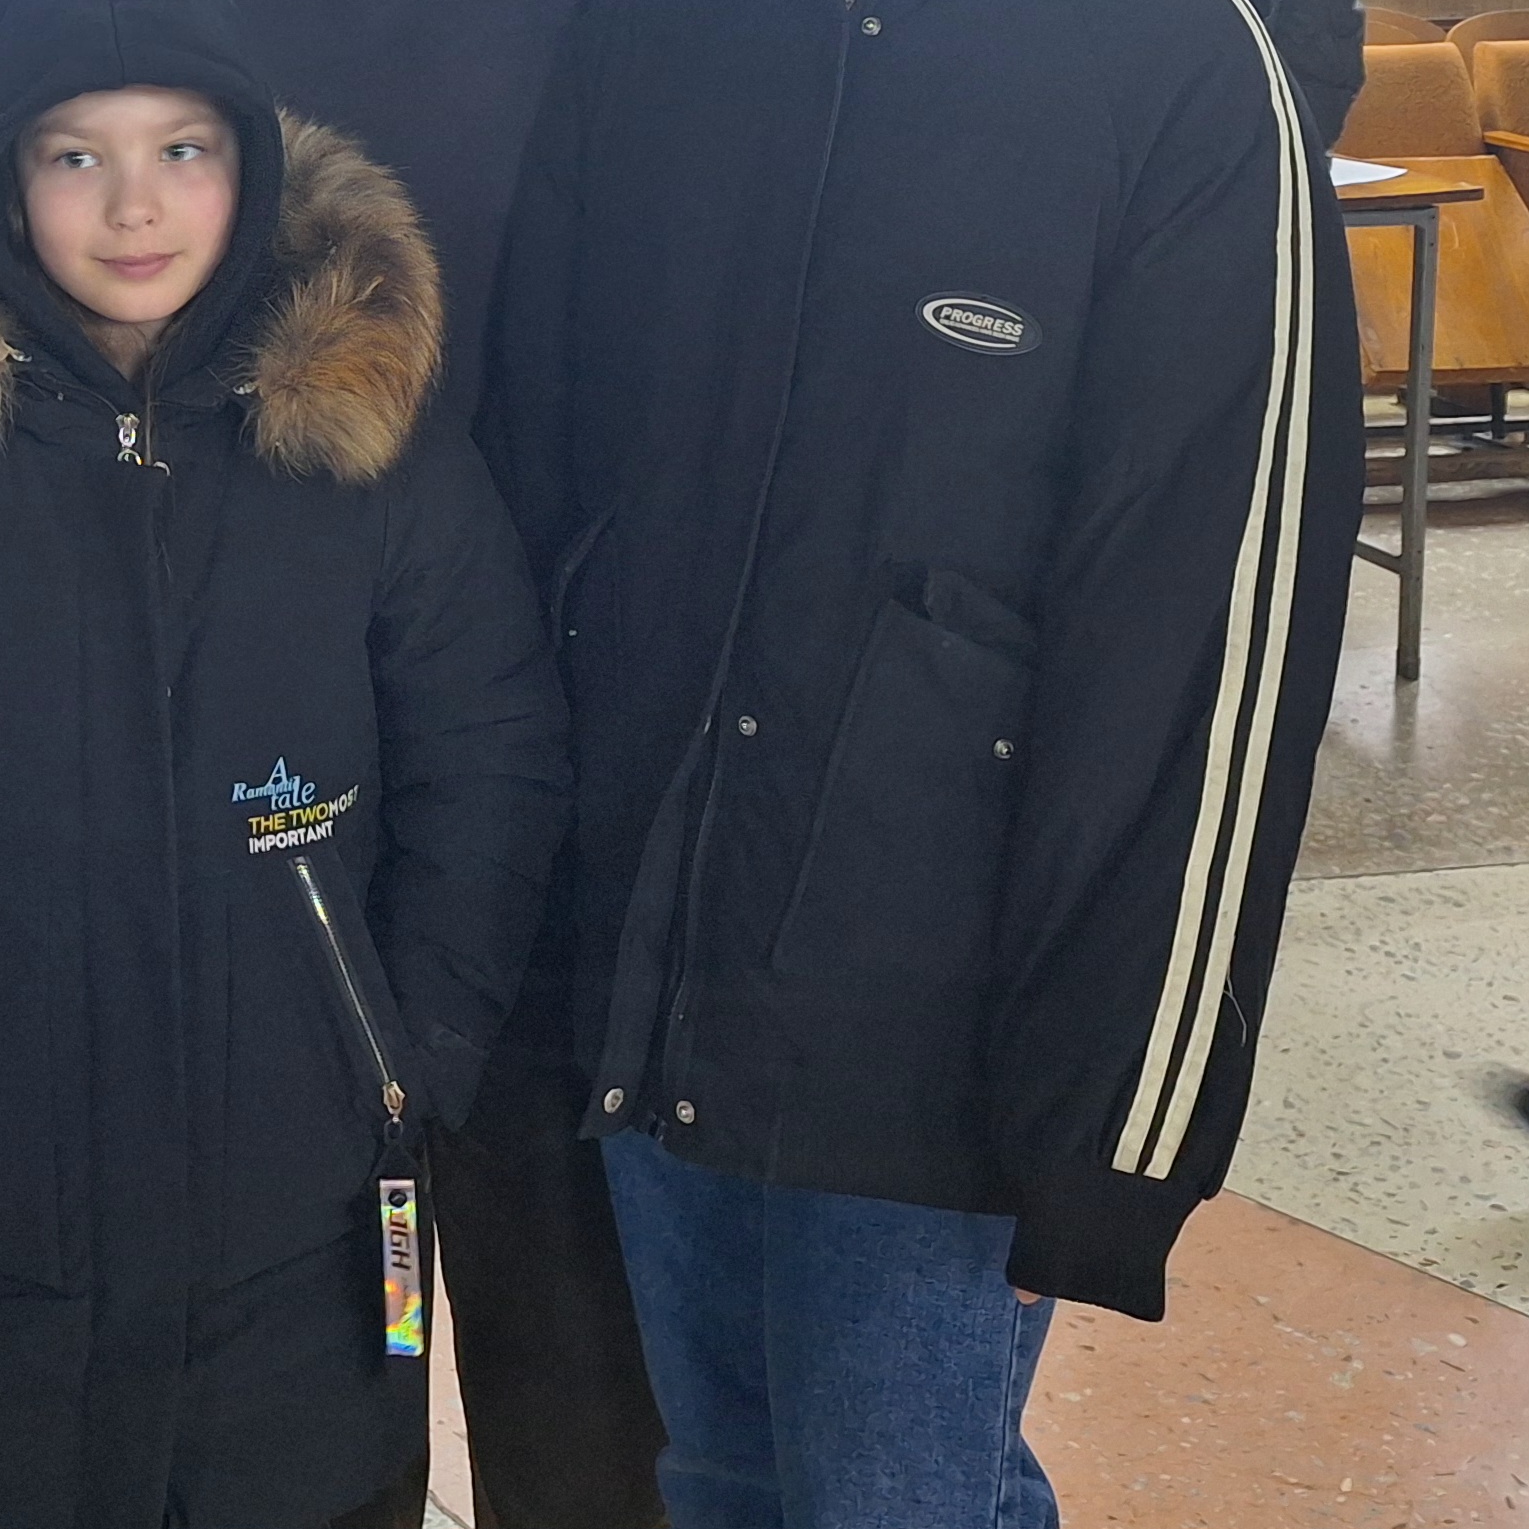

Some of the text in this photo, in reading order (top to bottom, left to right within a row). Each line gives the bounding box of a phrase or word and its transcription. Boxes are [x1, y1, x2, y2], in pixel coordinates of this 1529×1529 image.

[940, 306, 1024, 336] PROGRESS
[271, 775, 316, 811] tale
[248, 813, 286, 835] THE
[248, 820, 334, 854] IMPORTANT
